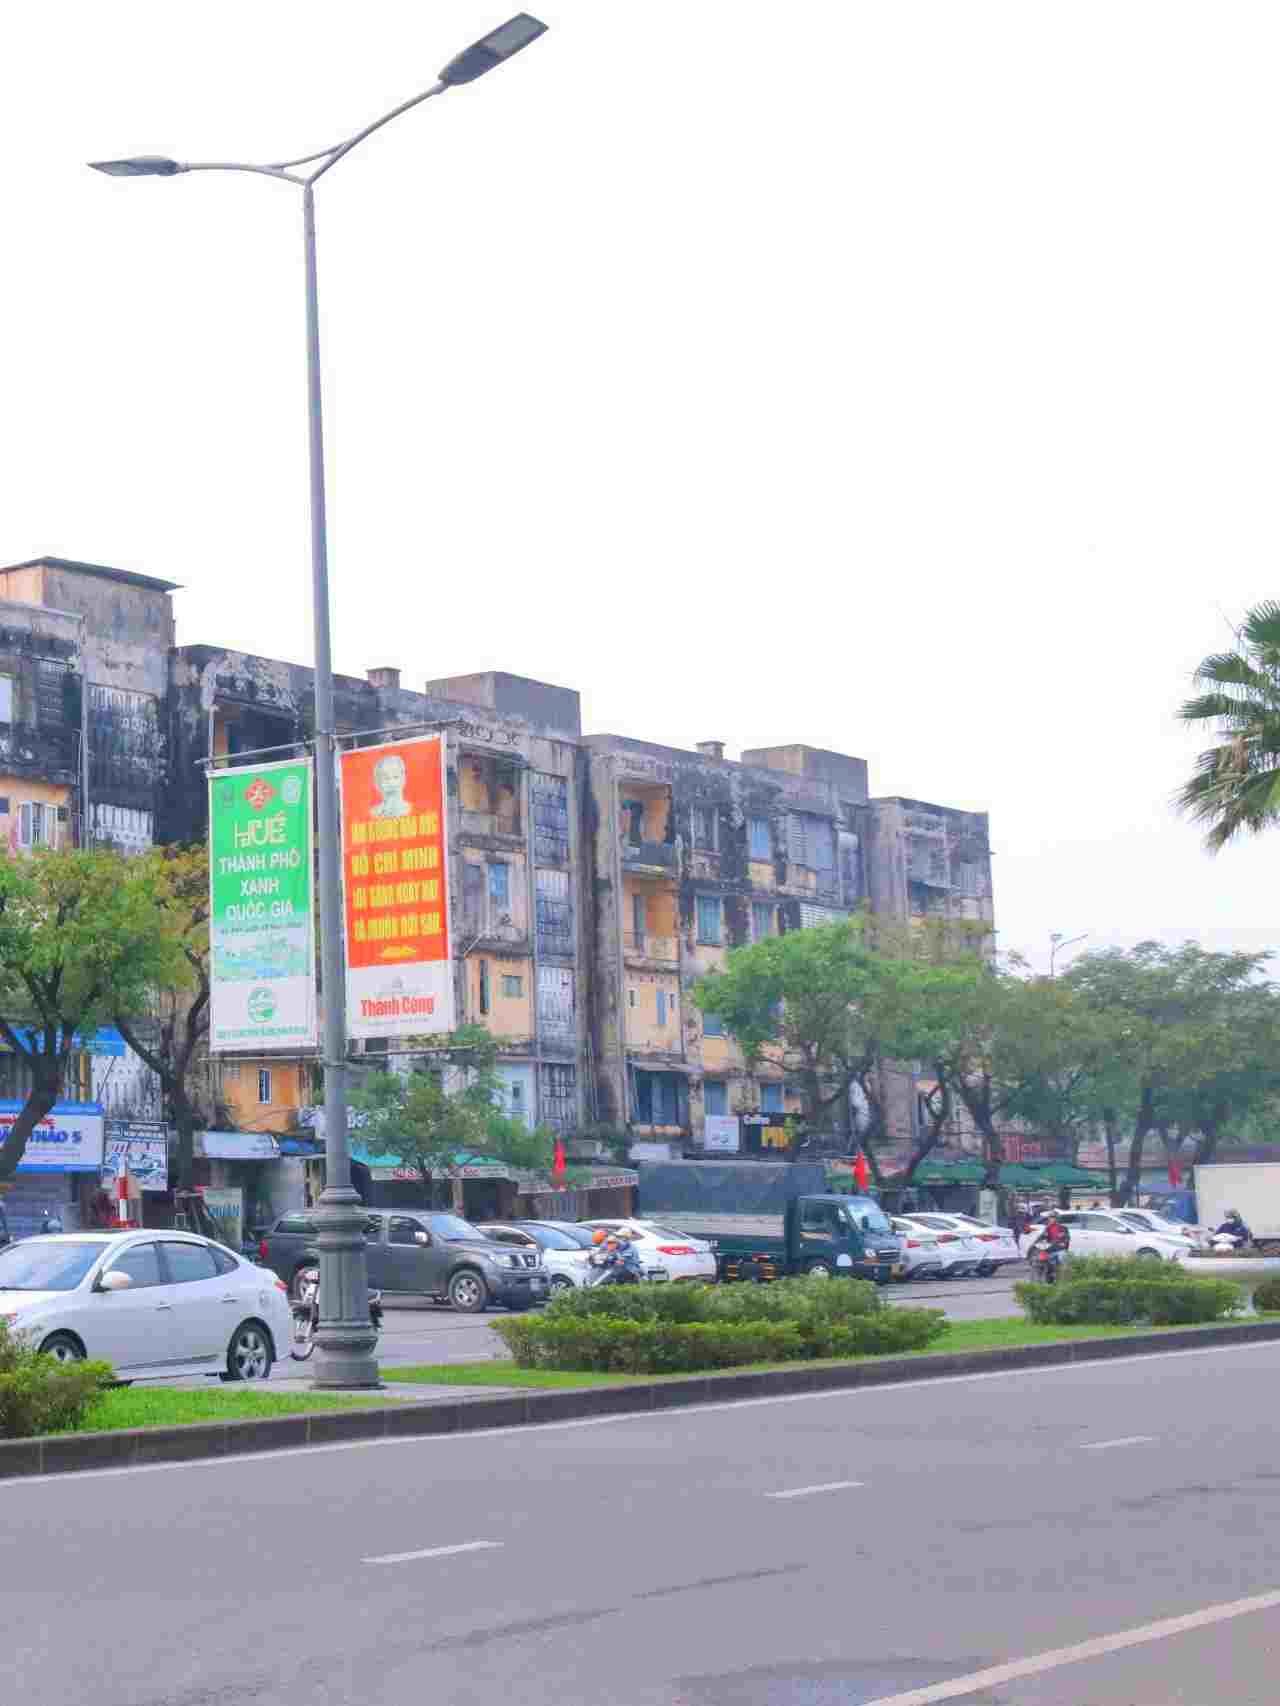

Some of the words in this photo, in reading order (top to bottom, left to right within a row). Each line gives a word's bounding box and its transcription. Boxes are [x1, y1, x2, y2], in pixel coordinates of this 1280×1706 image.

[234, 811, 287, 848] HUẾ
[219, 851, 265, 875] THÀNH
[240, 877, 280, 897] XANH
[224, 897, 266, 921] QUỐC
[271, 897, 294, 918] GIA
